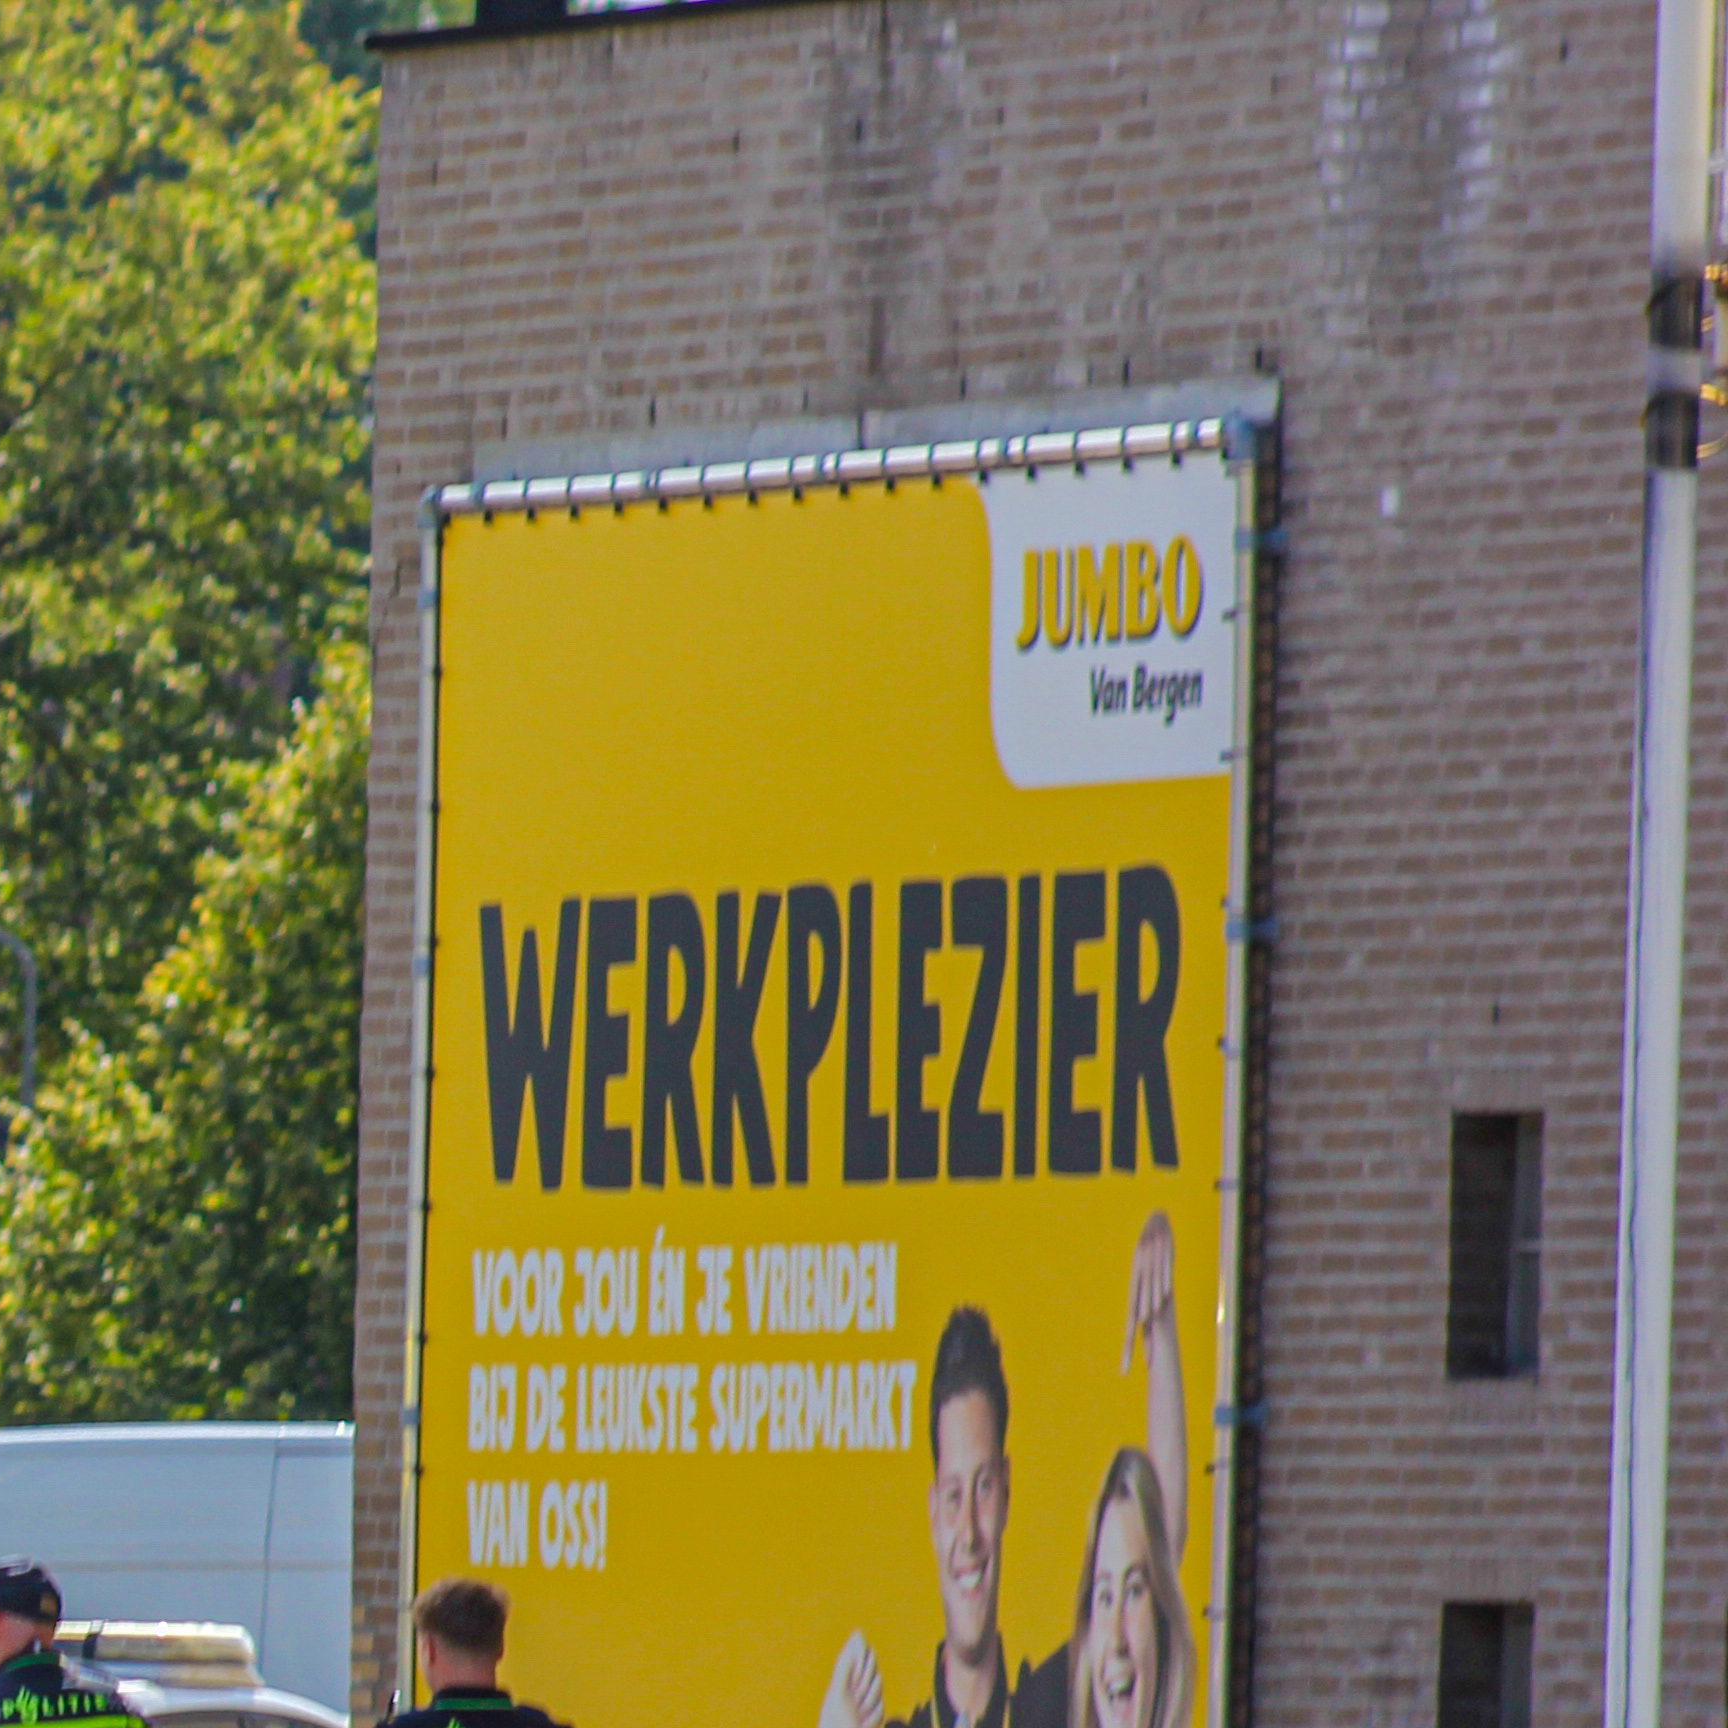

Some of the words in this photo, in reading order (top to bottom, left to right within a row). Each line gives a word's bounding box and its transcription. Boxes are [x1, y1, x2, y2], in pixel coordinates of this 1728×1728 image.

[1016, 533, 1204, 653] JUMBO
[1090, 664, 1127, 716] Van
[1133, 661, 1203, 729] Bergen
[479, 862, 1182, 1192] WERKPLEZIER
[472, 1247, 563, 1337] VOOR
[573, 1246, 639, 1337] JOU
[648, 1223, 685, 1336] ÉN
[695, 1244, 733, 1335] JE
[744, 1241, 897, 1335] VRIENDEN
[467, 1363, 517, 1453] BIJ
[526, 1363, 566, 1453] DE
[575, 1363, 699, 1454] LEUKSTE
[709, 1360, 917, 1453] SUPERMARKT
[467, 1478, 529, 1568] VAN
[538, 1478, 607, 1572] OSS!
[2, 1689, 108, 1724] POLITIE
